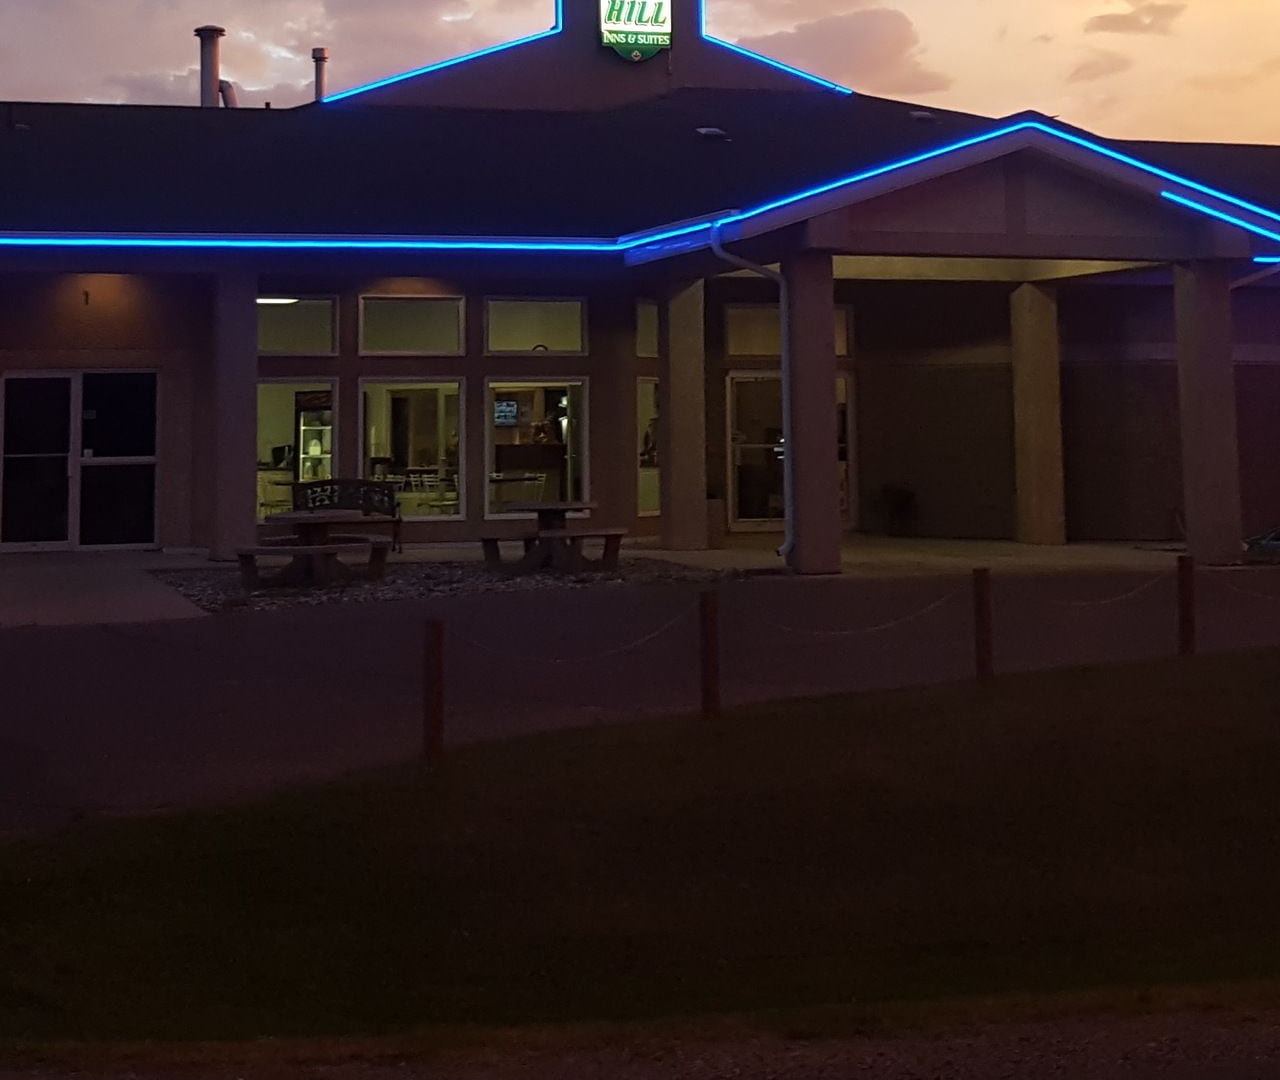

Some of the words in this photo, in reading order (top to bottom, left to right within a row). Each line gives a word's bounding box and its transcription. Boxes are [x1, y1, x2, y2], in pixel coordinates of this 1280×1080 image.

[605, 0, 667, 27] HILL
[603, 31, 626, 44] INNS
[627, 34, 635, 44] &
[637, 34, 671, 45] SUITES
